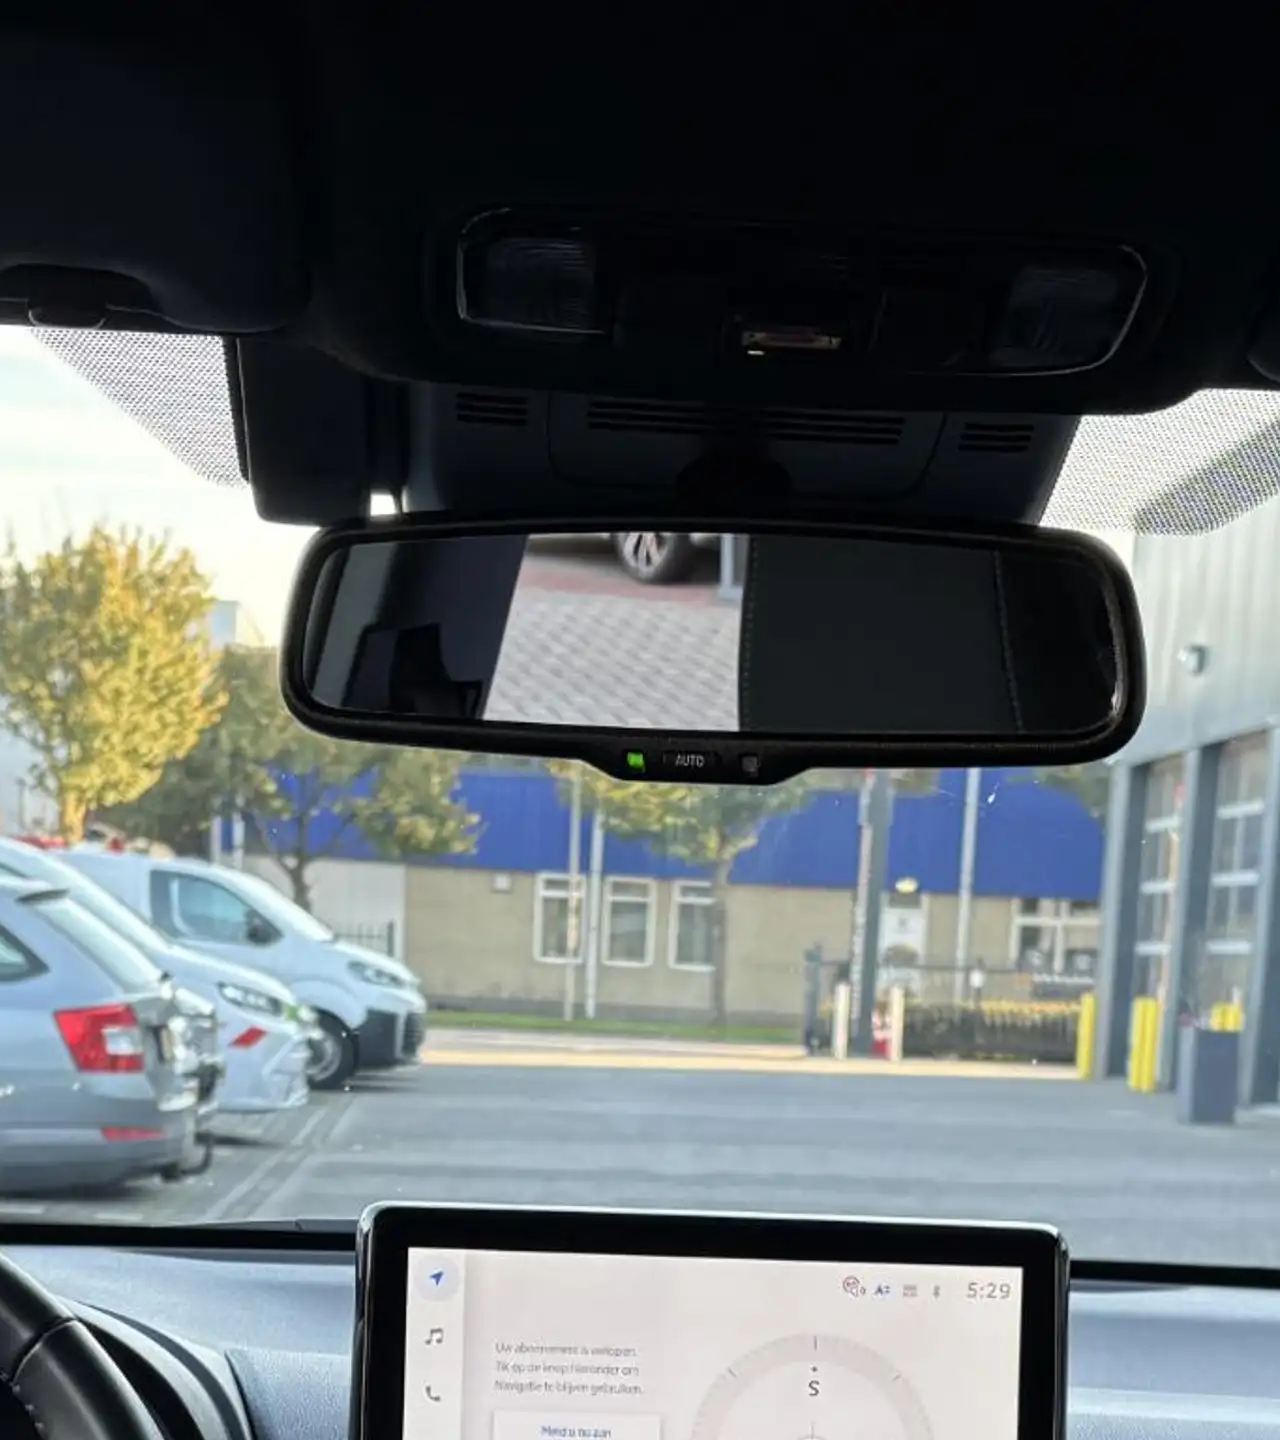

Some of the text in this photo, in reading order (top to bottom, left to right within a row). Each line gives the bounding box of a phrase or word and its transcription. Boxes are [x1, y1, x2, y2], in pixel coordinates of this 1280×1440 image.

[675, 753, 705, 767] AUTO
[967, 1281, 1012, 1299] 5:29
[808, 1380, 820, 1397] S
